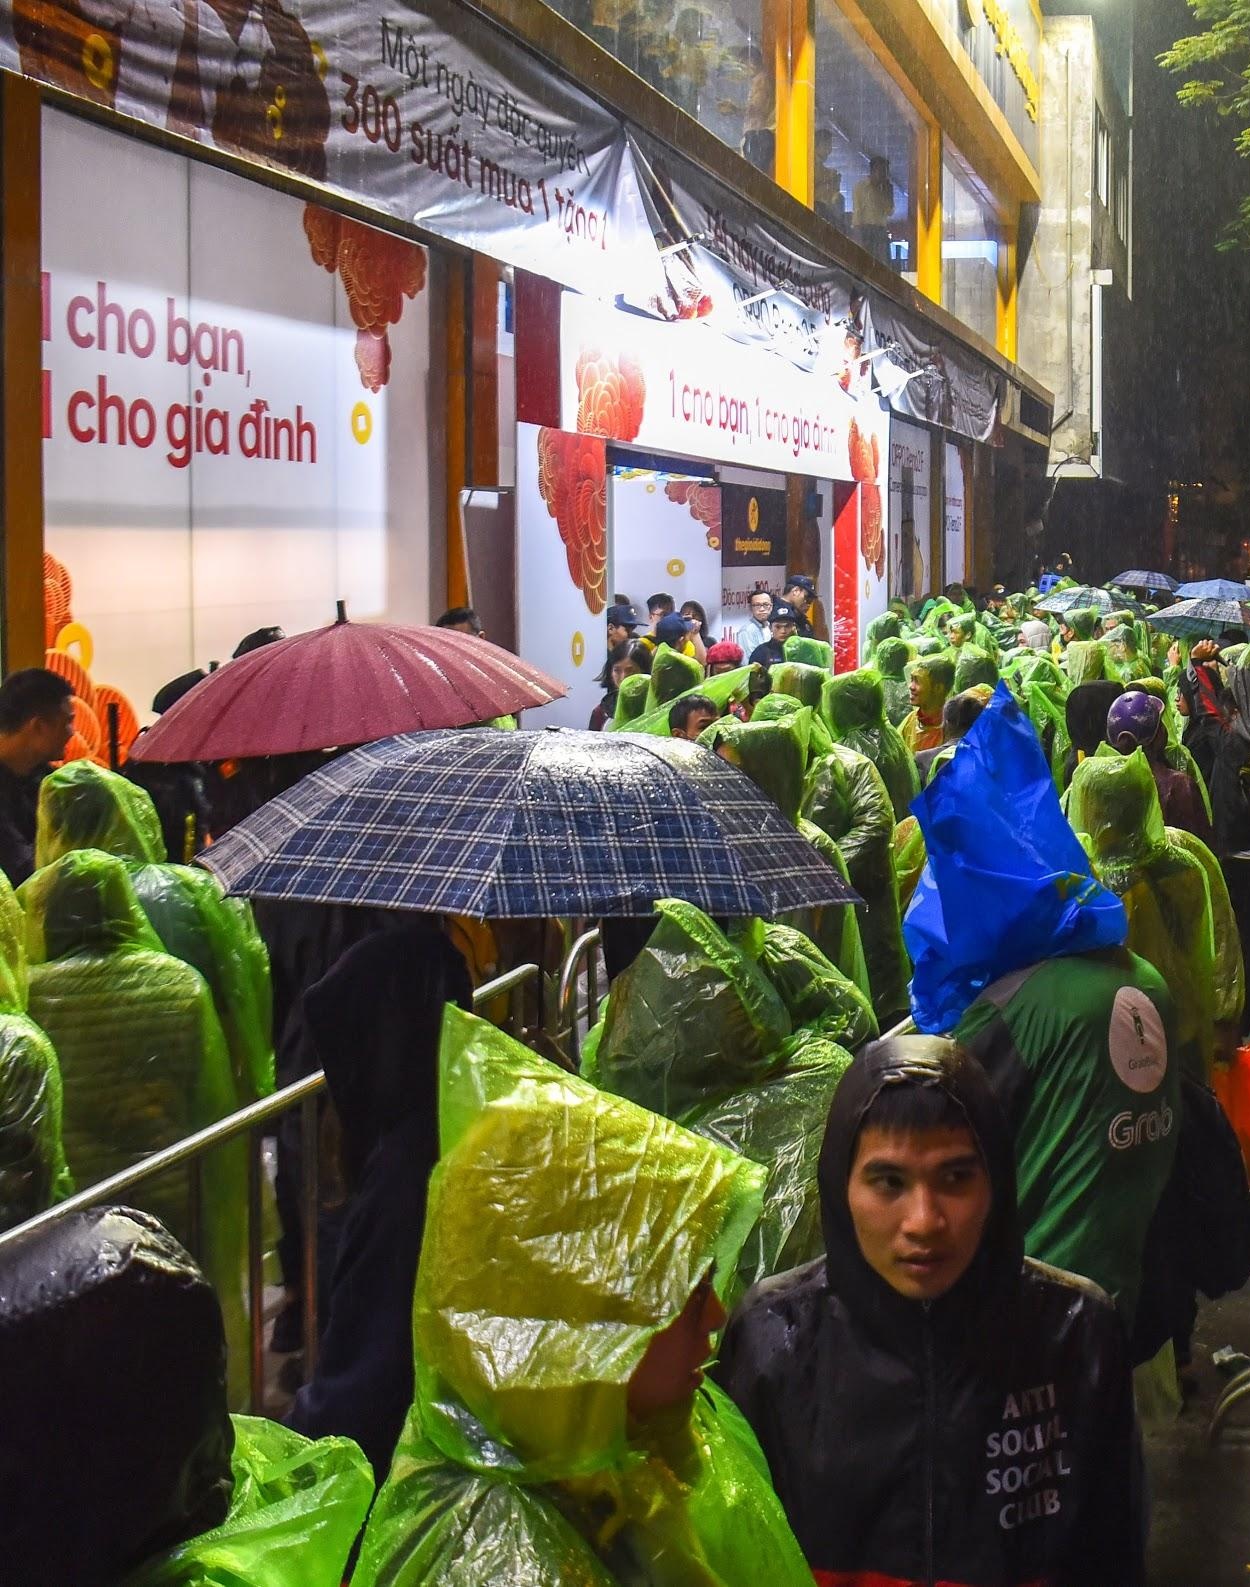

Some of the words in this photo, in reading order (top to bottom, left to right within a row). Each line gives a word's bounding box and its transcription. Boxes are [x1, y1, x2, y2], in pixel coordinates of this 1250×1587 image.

[381, 16, 429, 90] Một
[437, 61, 491, 131] ngày
[341, 72, 401, 153] 300
[410, 121, 473, 188] suất
[480, 155, 534, 215] mua
[538, 178, 550, 222] 1
[67, 281, 156, 359] cho
[166, 297, 251, 388] bạn,
[670, 368, 676, 418] 1
[68, 374, 157, 449] cho
[166, 389, 230, 469] gia
[238, 398, 317, 464] đình
[1108, 1096, 1174, 1150] Grab
[1002, 1383, 1056, 1420] ANTI
[985, 1414, 1068, 1459] SOCIAL
[985, 1449, 1072, 1495] SOCAL
[999, 1488, 1061, 1530] CLUB
